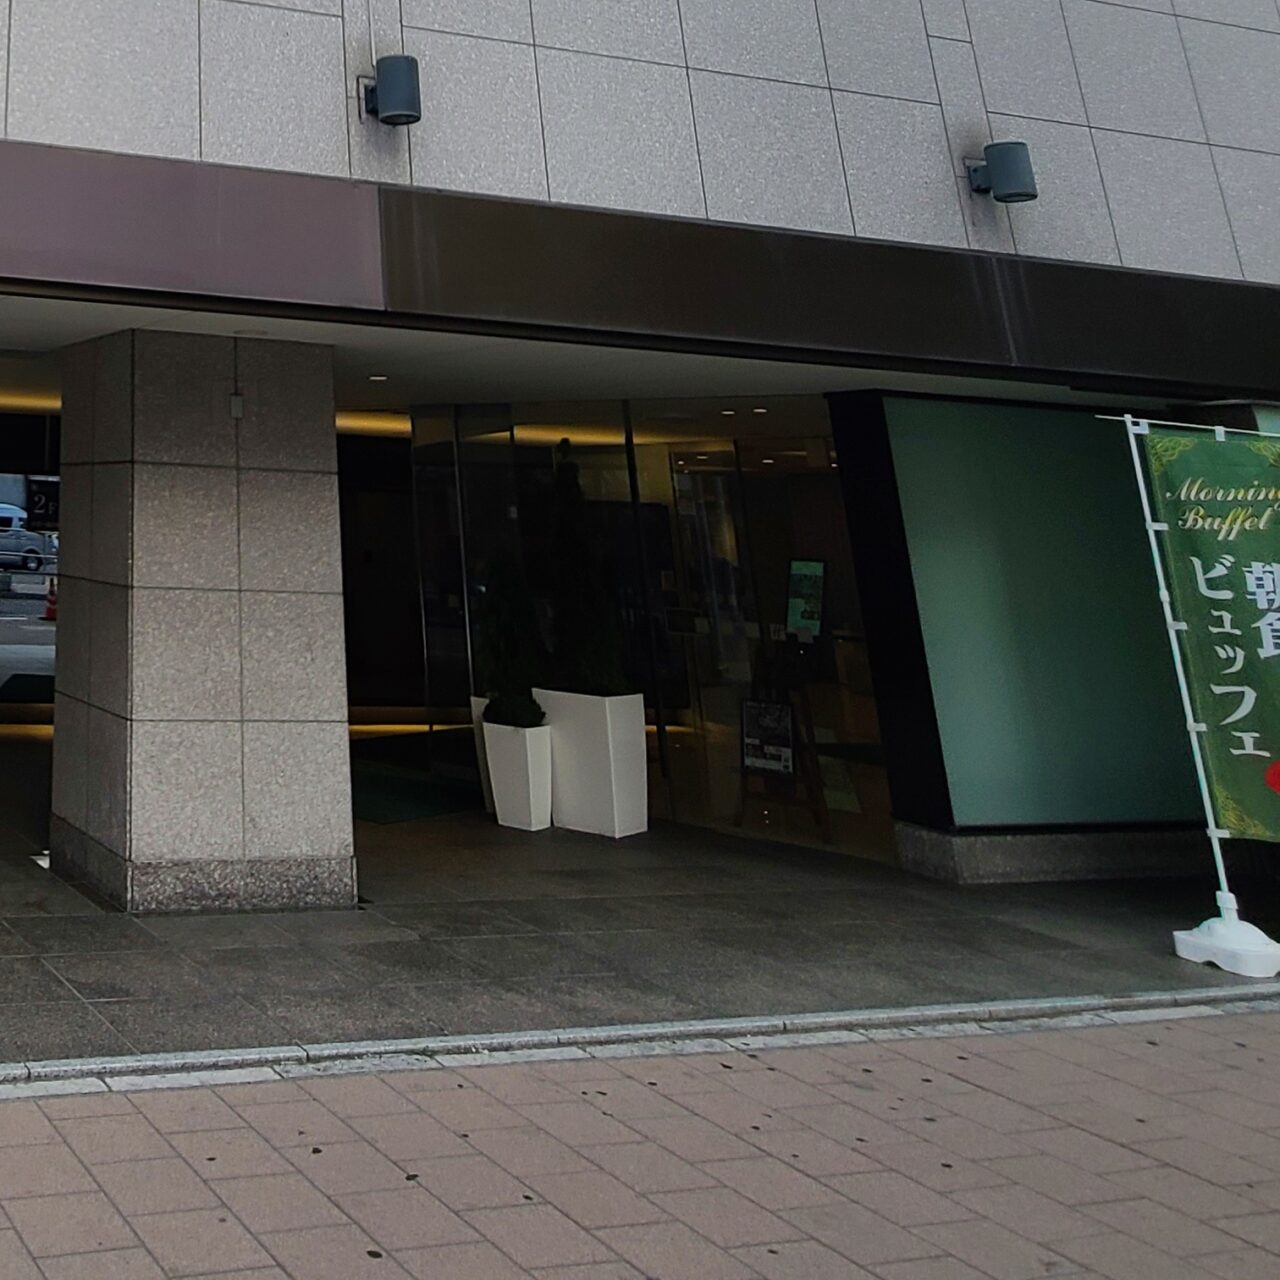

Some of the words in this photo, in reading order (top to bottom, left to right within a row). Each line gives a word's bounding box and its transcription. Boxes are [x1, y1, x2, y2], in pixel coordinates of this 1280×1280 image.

[1166, 477, 1280, 511] Mornin
[1178, 505, 1274, 541] Buffet
[1190, 554, 1271, 758] ビュッフェ
